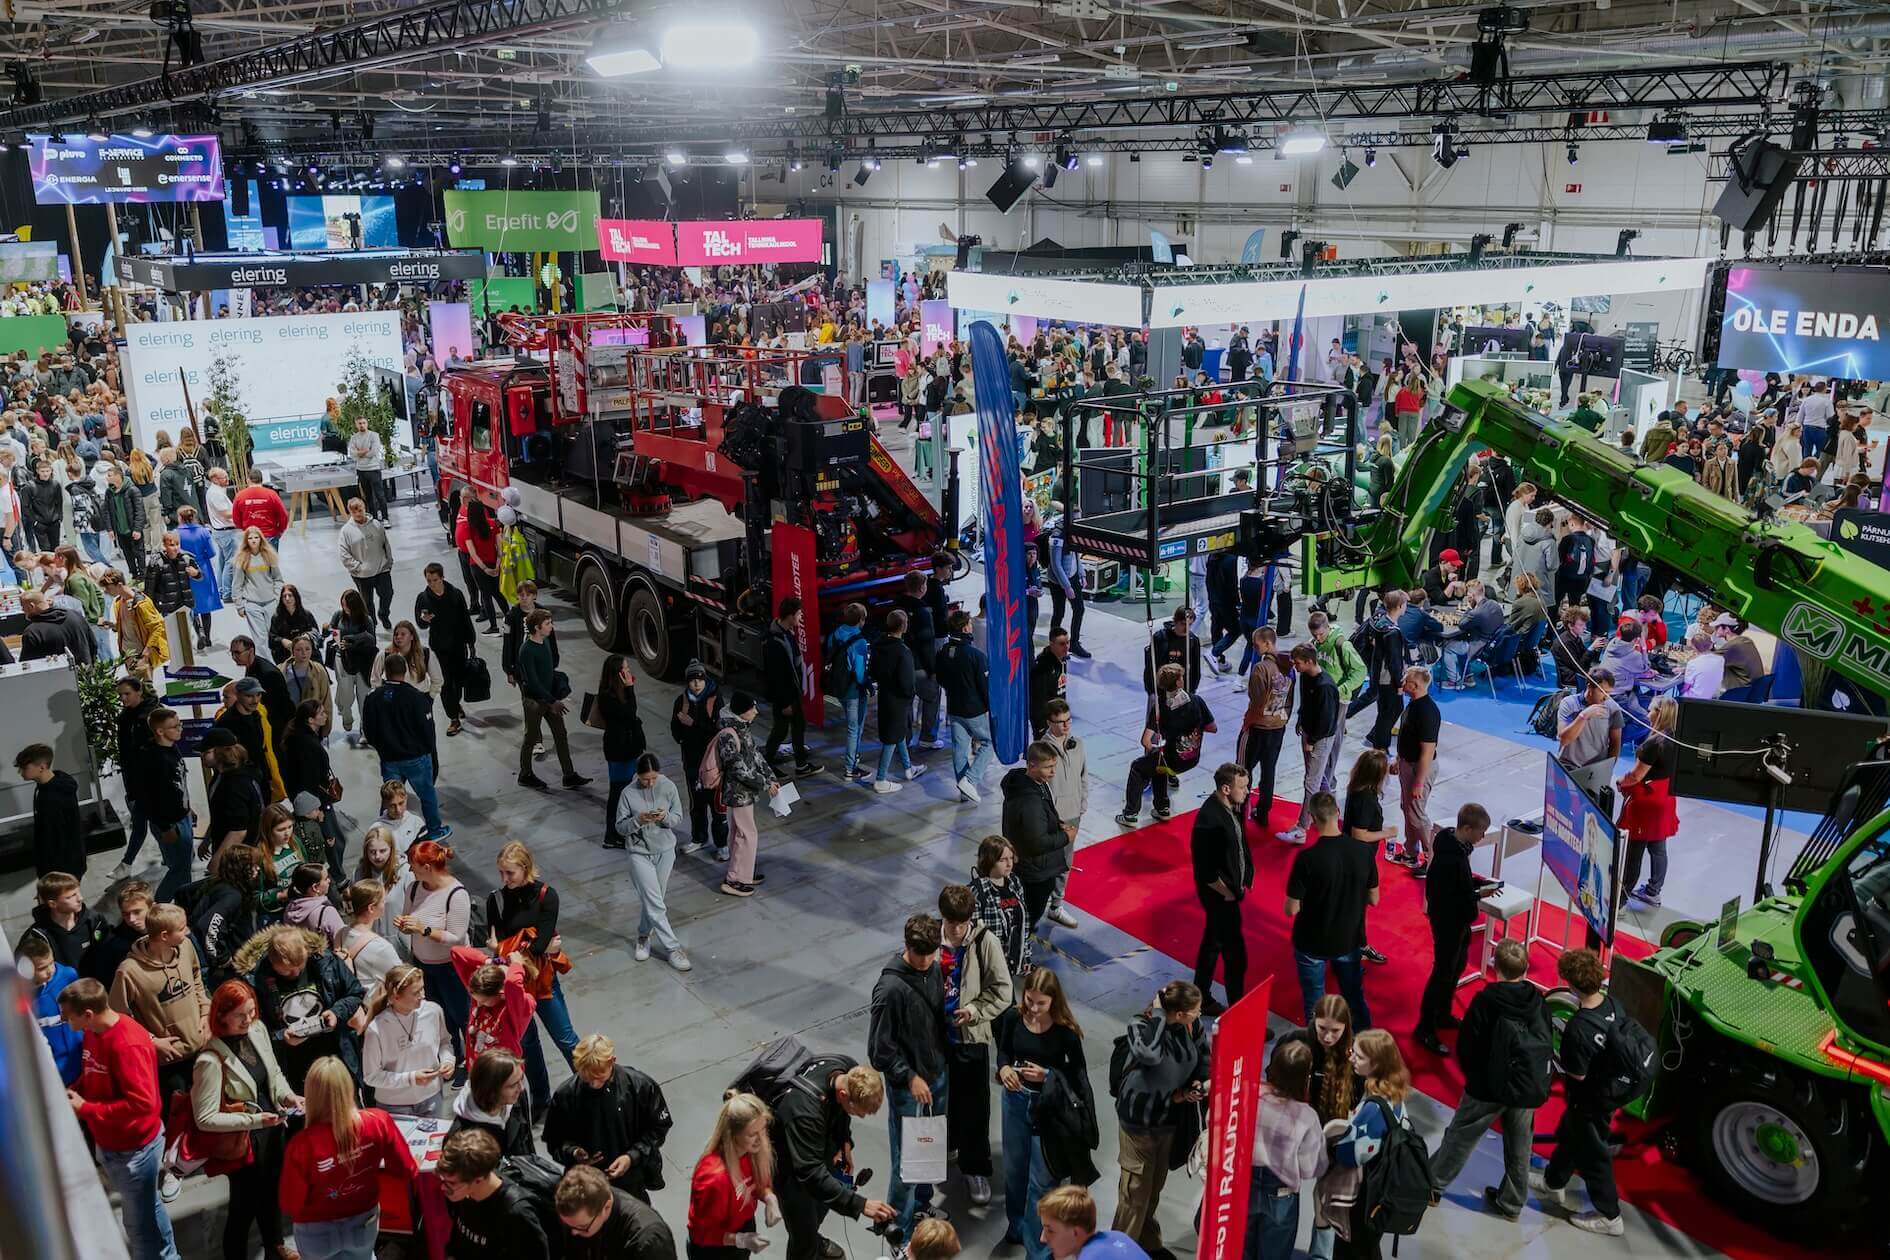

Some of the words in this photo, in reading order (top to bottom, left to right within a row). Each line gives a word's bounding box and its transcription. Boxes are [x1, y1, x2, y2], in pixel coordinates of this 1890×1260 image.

[486, 214, 542, 230] Enefit
[609, 228, 624, 241] TAL
[703, 230, 729, 244] TAL
[611, 240, 631, 254] TECH
[704, 243, 742, 257] TECH
[231, 266, 287, 285] elering
[389, 261, 440, 279] elering
[279, 325, 328, 340] elering
[344, 320, 391, 336] elering
[1733, 308, 1790, 335] OLE
[1795, 311, 1880, 341] ENDA
[139, 331, 194, 348] elering
[211, 328, 263, 343] elering
[270, 425, 320, 440] elering
[1843, 633, 1890, 678] M
[1219, 1056, 1243, 1196] RAUDTEE
